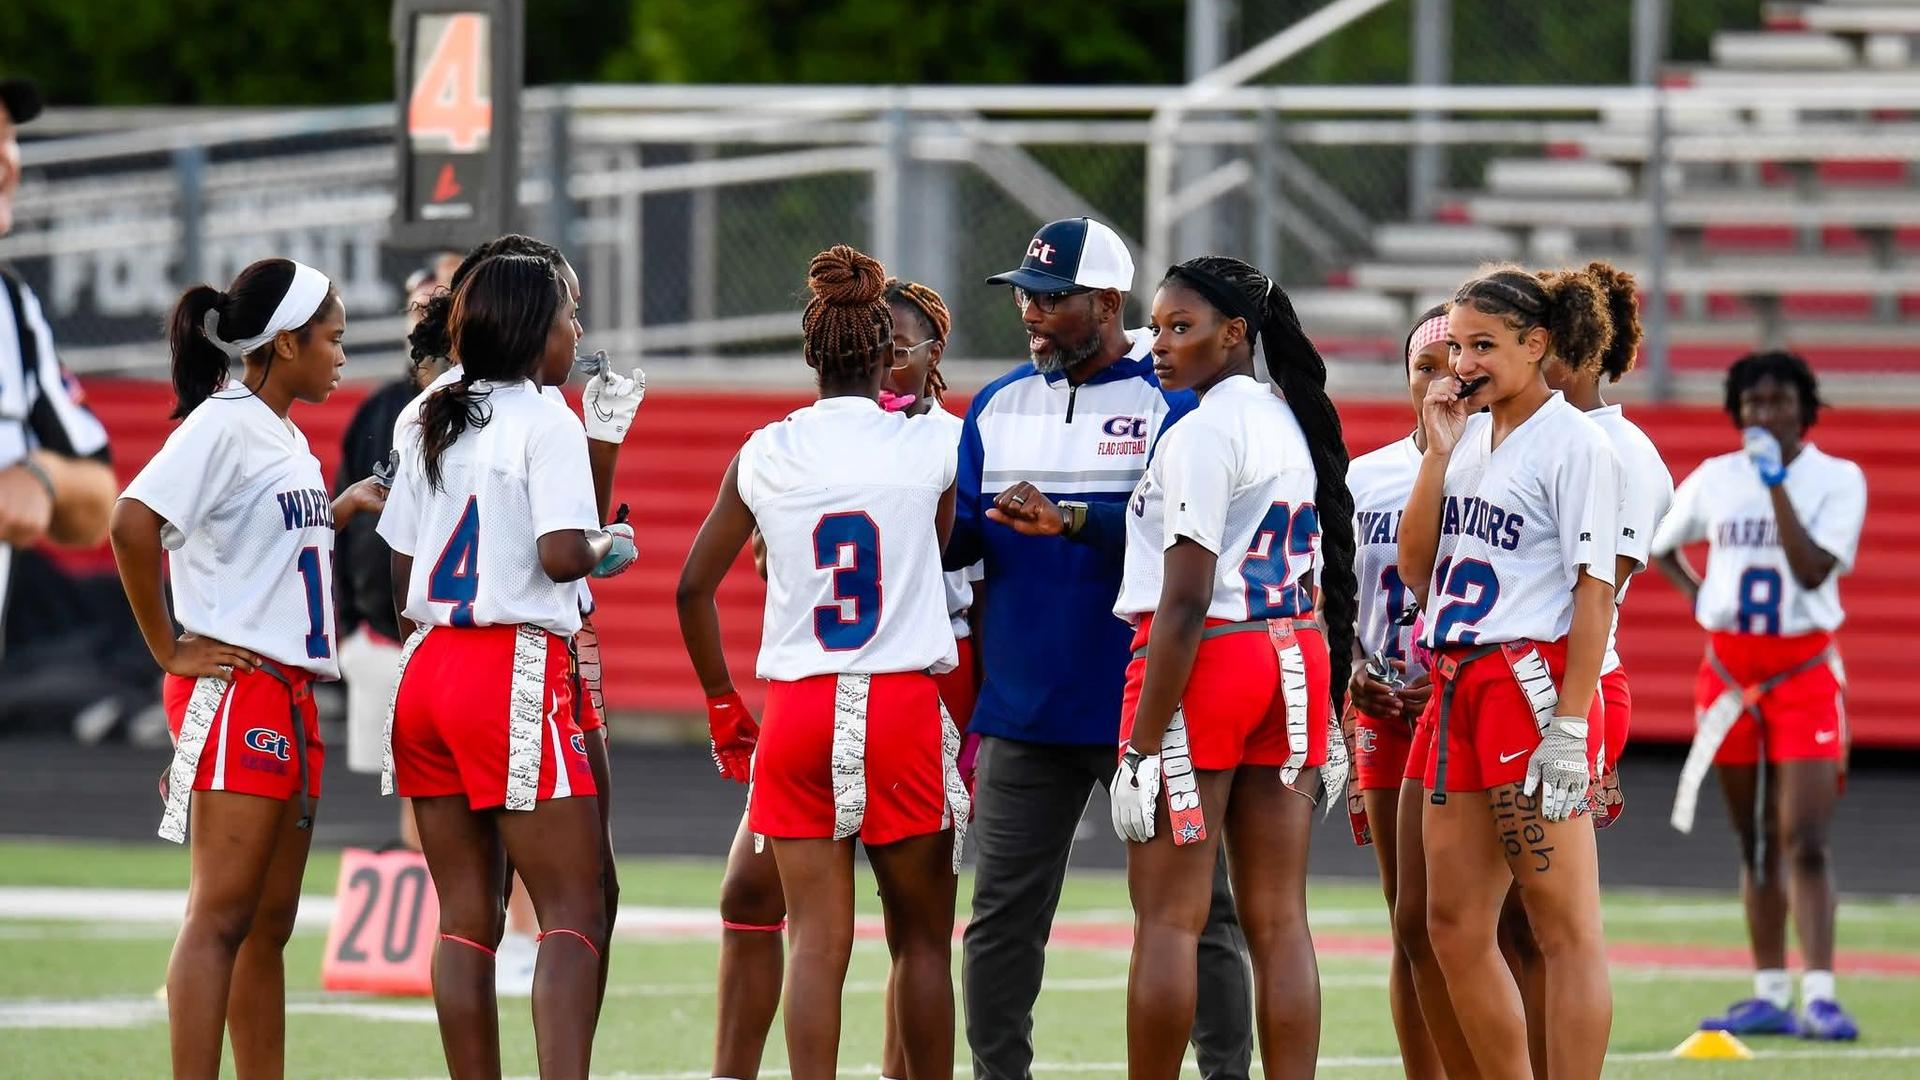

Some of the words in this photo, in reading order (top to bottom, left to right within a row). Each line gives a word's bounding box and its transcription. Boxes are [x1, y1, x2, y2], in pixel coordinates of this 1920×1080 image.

[408, 12, 493, 150] 4
[1027, 238, 1056, 264] Gt
[1098, 442, 1116, 455] FLAG
[1102, 416, 1147, 439] Gt
[428, 494, 480, 627] 4
[812, 510, 883, 652] 3
[245, 727, 291, 761] Gt
[1278, 643, 1308, 785] WARRIORS
[337, 866, 427, 963] 20
